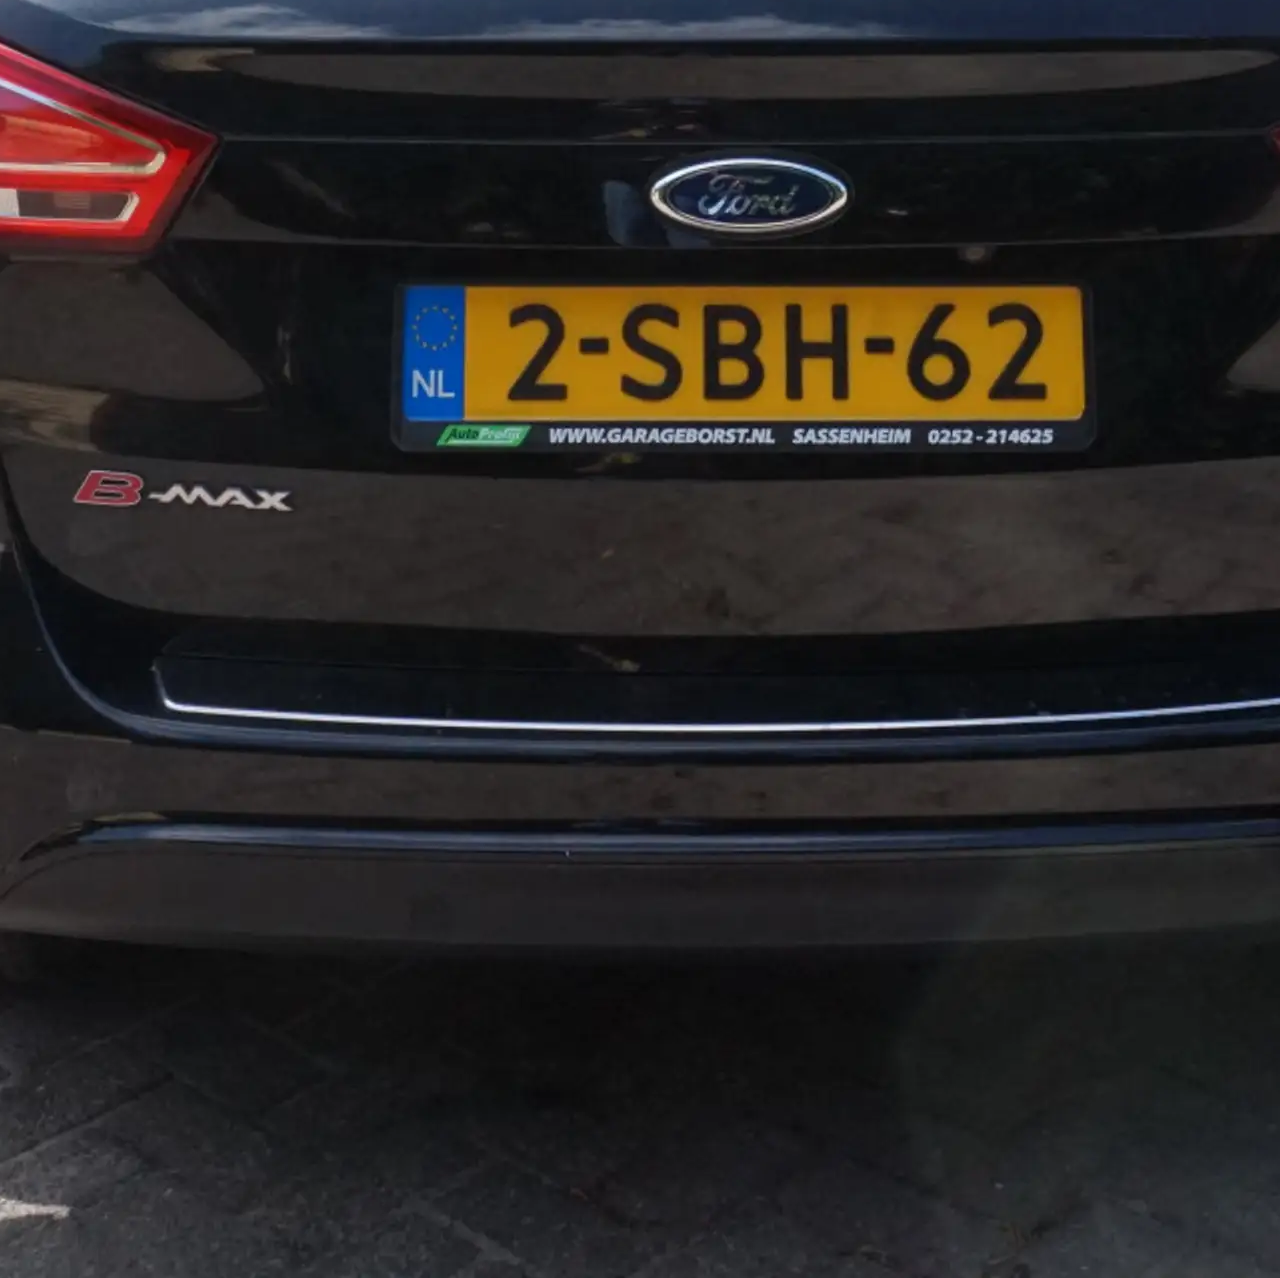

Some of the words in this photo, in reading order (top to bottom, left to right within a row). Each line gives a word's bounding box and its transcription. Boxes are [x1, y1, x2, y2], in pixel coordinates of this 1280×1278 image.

[698, 174, 800, 216] Ford
[508, 303, 1048, 402] 2-SBH-62
[412, 370, 455, 398] NL
[549, 428, 775, 444] WWW.GARAGEBORST.NL
[792, 428, 911, 444] SASSENHEIM
[73, 470, 294, 511] B-MAX
